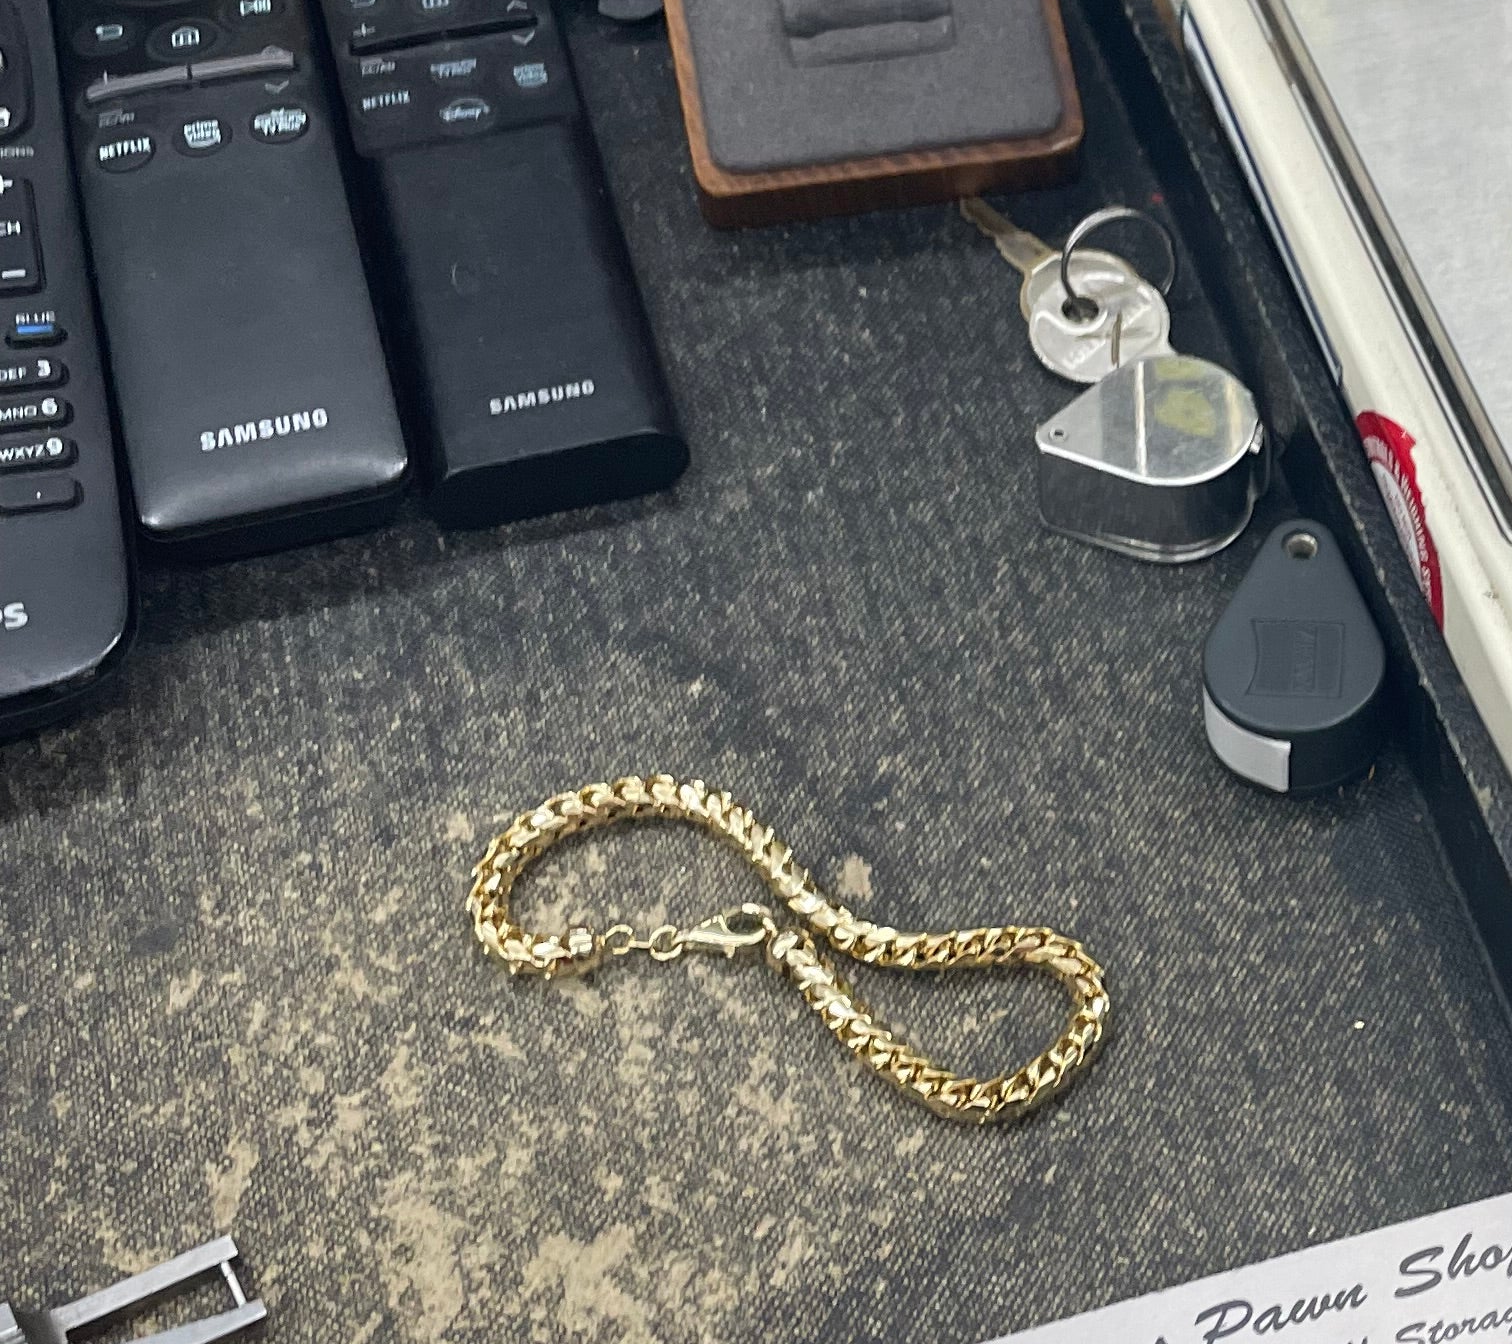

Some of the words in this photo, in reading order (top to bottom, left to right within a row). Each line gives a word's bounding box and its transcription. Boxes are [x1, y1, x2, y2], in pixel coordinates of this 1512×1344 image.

[99, 136, 150, 161] NETFLIX
[37, 359, 51, 378] 3
[41, 397, 59, 417] 6
[490, 379, 596, 416] SAMSUNG
[200, 408, 329, 452] SAMSUNG
[47, 436, 63, 457] 9
